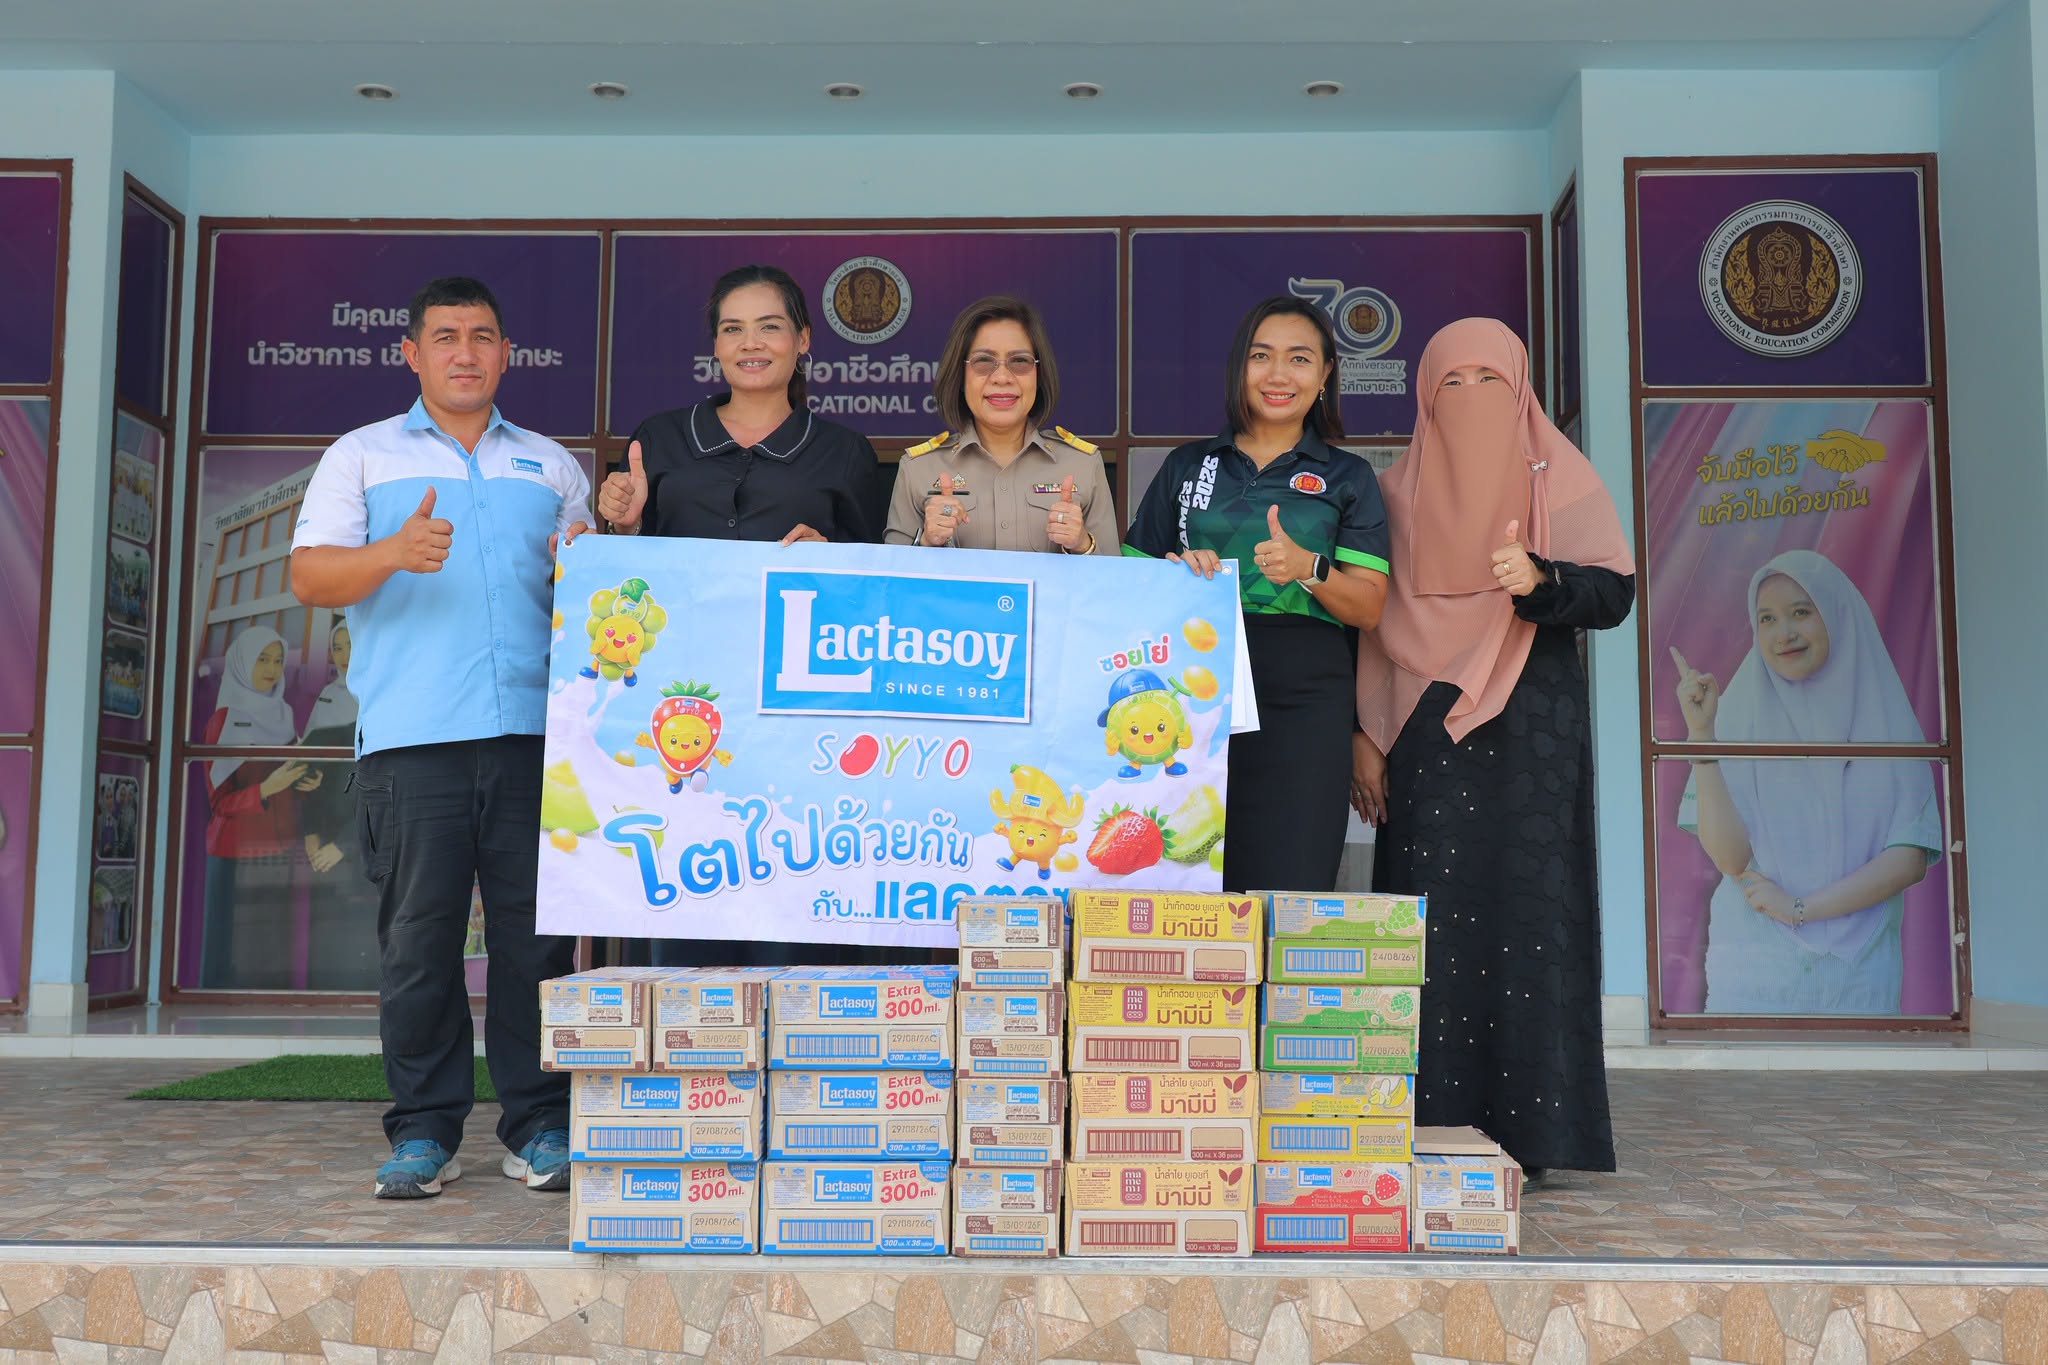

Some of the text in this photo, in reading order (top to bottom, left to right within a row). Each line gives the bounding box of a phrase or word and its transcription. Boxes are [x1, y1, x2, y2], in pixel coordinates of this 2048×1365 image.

[332, 302, 410, 334] มีคุณธ
[1710, 290, 1851, 348] VOCATIONAL EDUCATION COMMISSION
[248, 341, 372, 366] นำวิชาการ
[1341, 360, 1403, 372] Anniversary
[807, 395, 916, 413] CATIONAL
[1696, 445, 1800, 485] จับมือไว้
[1192, 455, 1219, 511] 2026
[1698, 481, 1870, 526] แล้วไปด้วยกัน
[1178, 480, 1193, 552] AMES
[776, 589, 1019, 693] Lactasoy
[1100, 635, 1169, 672] ซอยโย่
[885, 682, 1000, 699] SINCE 1981
[603, 798, 974, 908] โตไปด้วยกัน
[1163, 914, 1218, 937] มามีมี่
[1373, 953, 1416, 961] 24/08/26Y
[888, 984, 920, 998] Extra
[821, 992, 875, 1015] Lactasoy
[885, 998, 922, 1019] 300
[1157, 1000, 1212, 1024] มามีมี่
[691, 1075, 725, 1089] Extra
[888, 1075, 922, 1088] Extra
[1301, 1078, 1332, 1092] Lactasoy
[623, 1082, 679, 1107] Lactasoy
[688, 1090, 726, 1110] 300
[821, 1082, 876, 1106] Lactasoy
[885, 1089, 923, 1109] 300
[1161, 1089, 1216, 1114] มามีมี่
[696, 1127, 741, 1135] 29/08/26C
[691, 1167, 725, 1180] Extra
[883, 1169, 917, 1182] Extra
[1300, 1170, 1331, 1185] Lactasoy
[623, 1174, 679, 1198] Lactasoy
[688, 1181, 726, 1202] 300
[816, 1175, 871, 1200] Lactasoy
[880, 1182, 918, 1203] 300
[1156, 1181, 1211, 1206] มามีมี่
